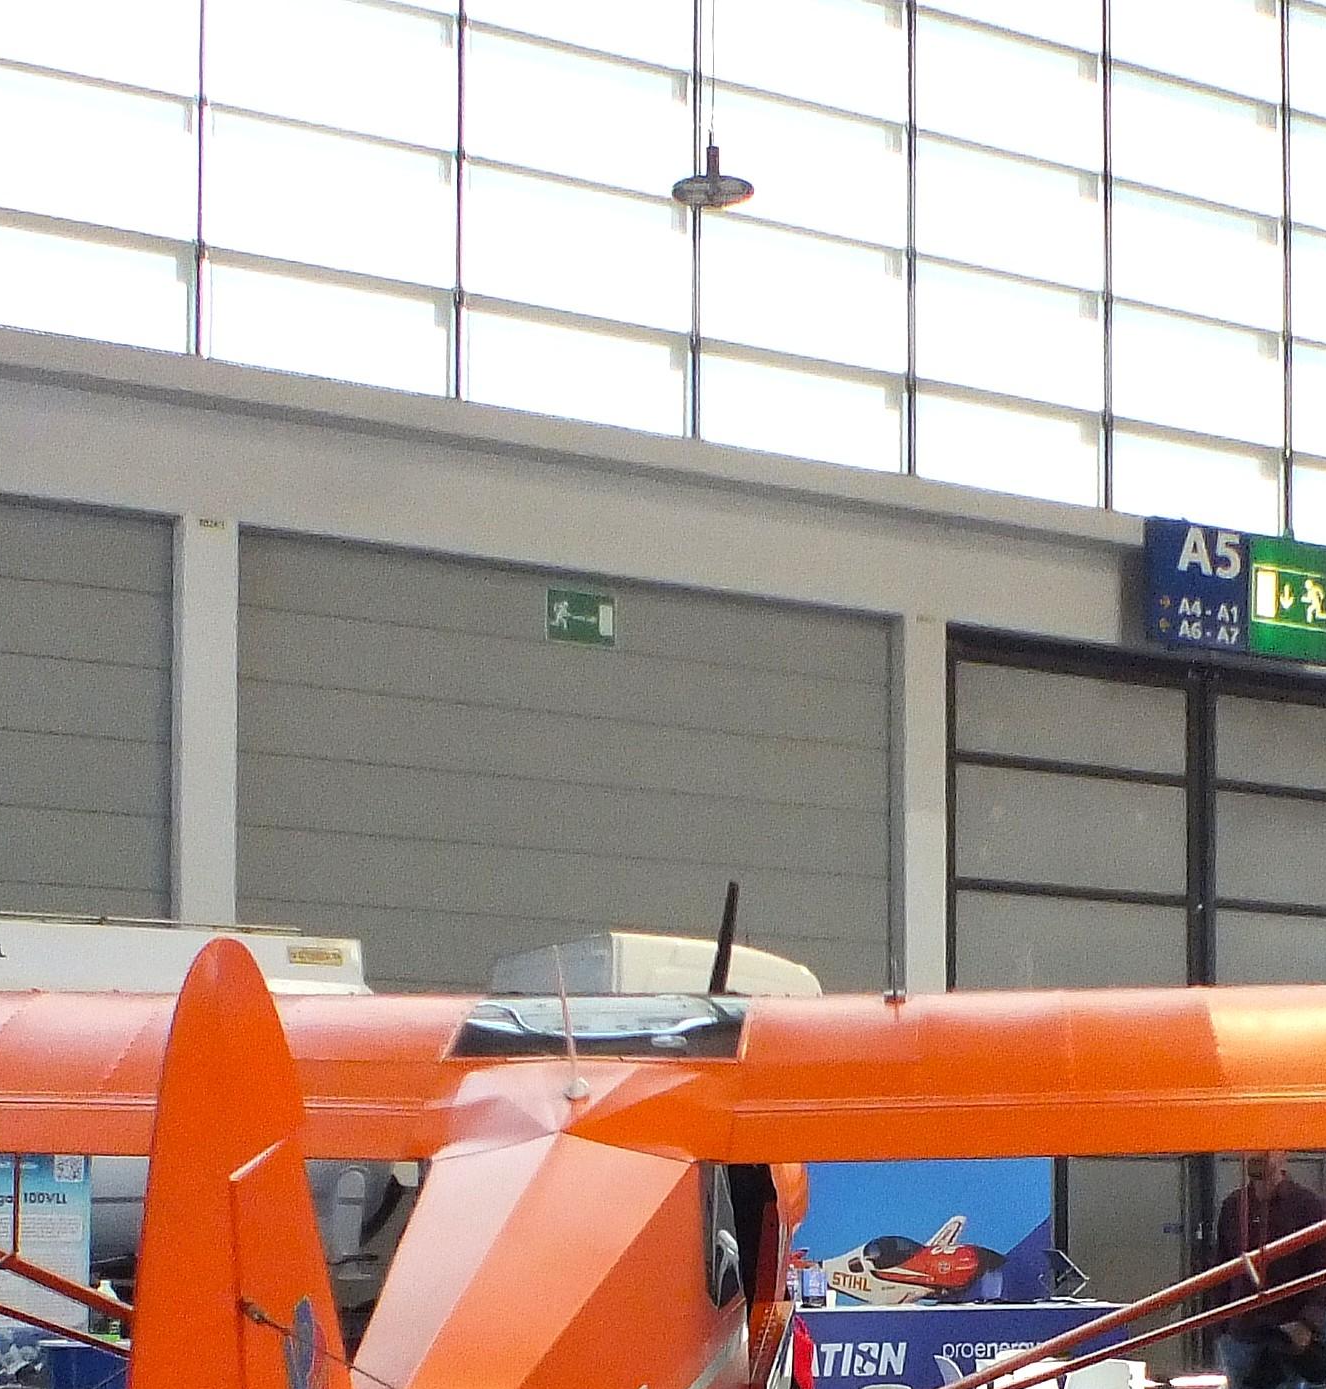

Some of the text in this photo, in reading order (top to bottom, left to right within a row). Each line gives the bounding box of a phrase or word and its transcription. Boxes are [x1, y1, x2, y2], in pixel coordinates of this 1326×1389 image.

[1177, 527, 1241, 579] A5
[1178, 597, 1201, 616] A4
[1216, 602, 1239, 623] A1
[1178, 619, 1202, 640] A6
[1216, 625, 1240, 645] A7
[831, 1271, 872, 1292] STIHL
